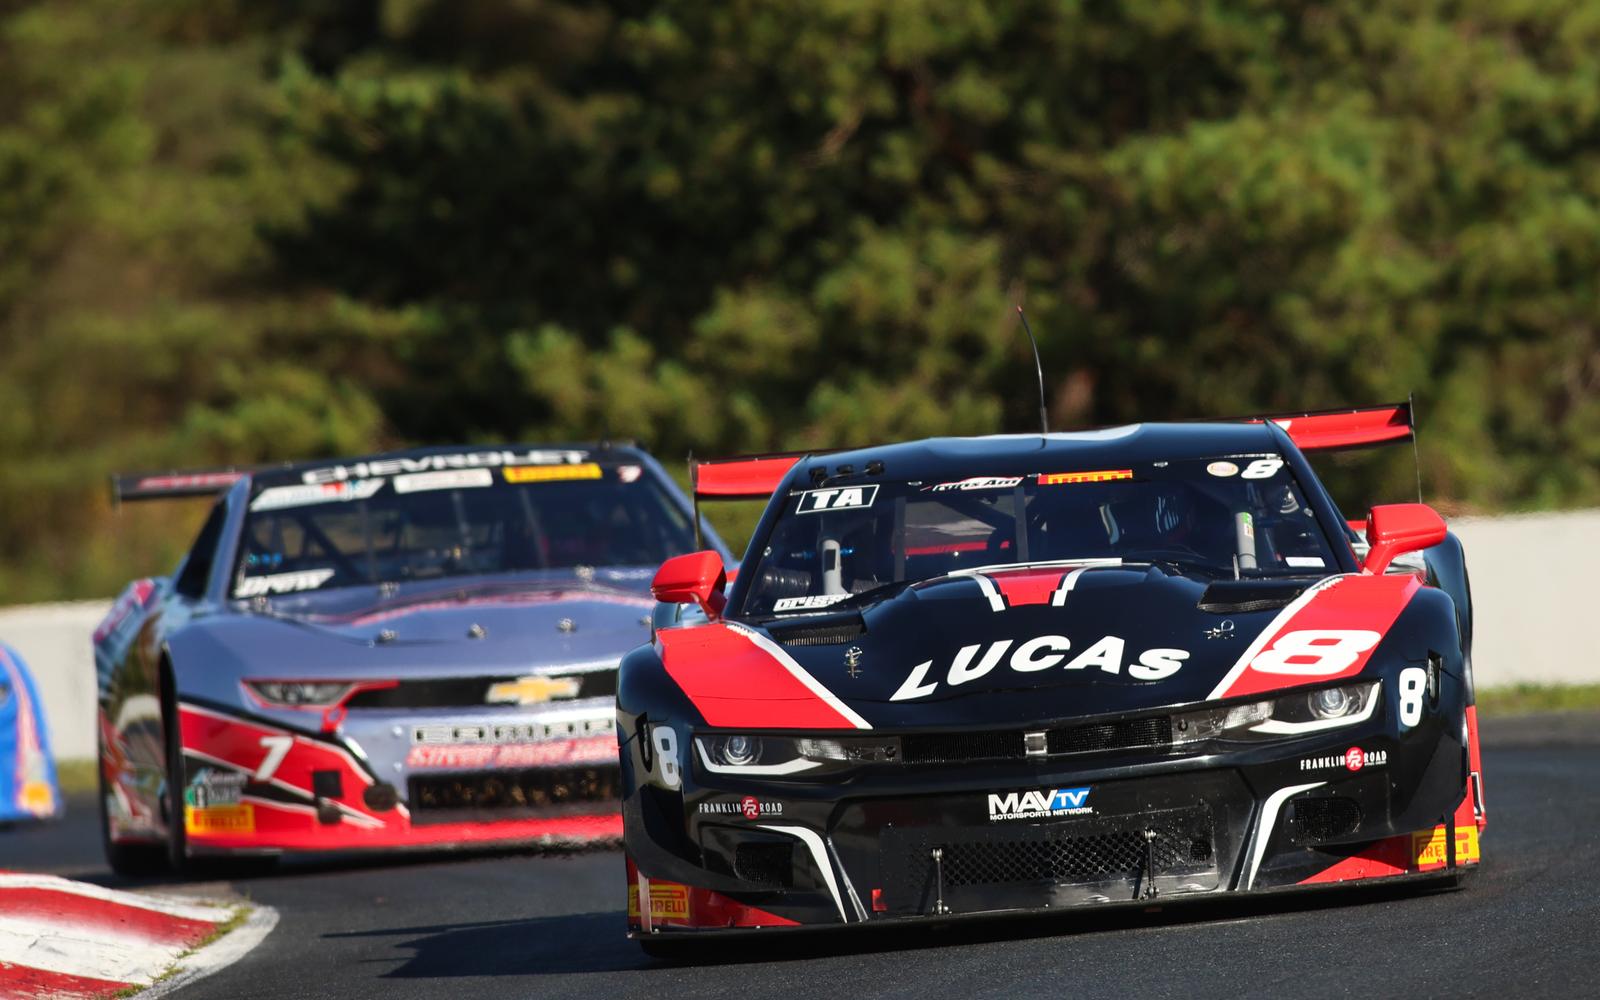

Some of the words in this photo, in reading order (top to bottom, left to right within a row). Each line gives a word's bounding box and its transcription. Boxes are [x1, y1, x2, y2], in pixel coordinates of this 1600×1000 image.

[302, 450, 589, 484] CHEVROLET
[1241, 459, 1284, 479] 8
[812, 488, 862, 509] TA
[1250, 629, 1382, 676] 8
[889, 635, 1191, 702] LUCAS
[1399, 667, 1427, 727] 8
[256, 736, 294, 780] 7
[653, 726, 680, 786] 8
[1300, 755, 1346, 770] FRANKLIN
[1363, 751, 1387, 763] ROAD
[699, 803, 741, 813] FRANKLIN
[760, 802, 783, 812] ROAD
[988, 789, 1090, 815] MAVTV
[990, 811, 1052, 821] MOTORSPORTS
[1053, 807, 1093, 816] NETWORK
